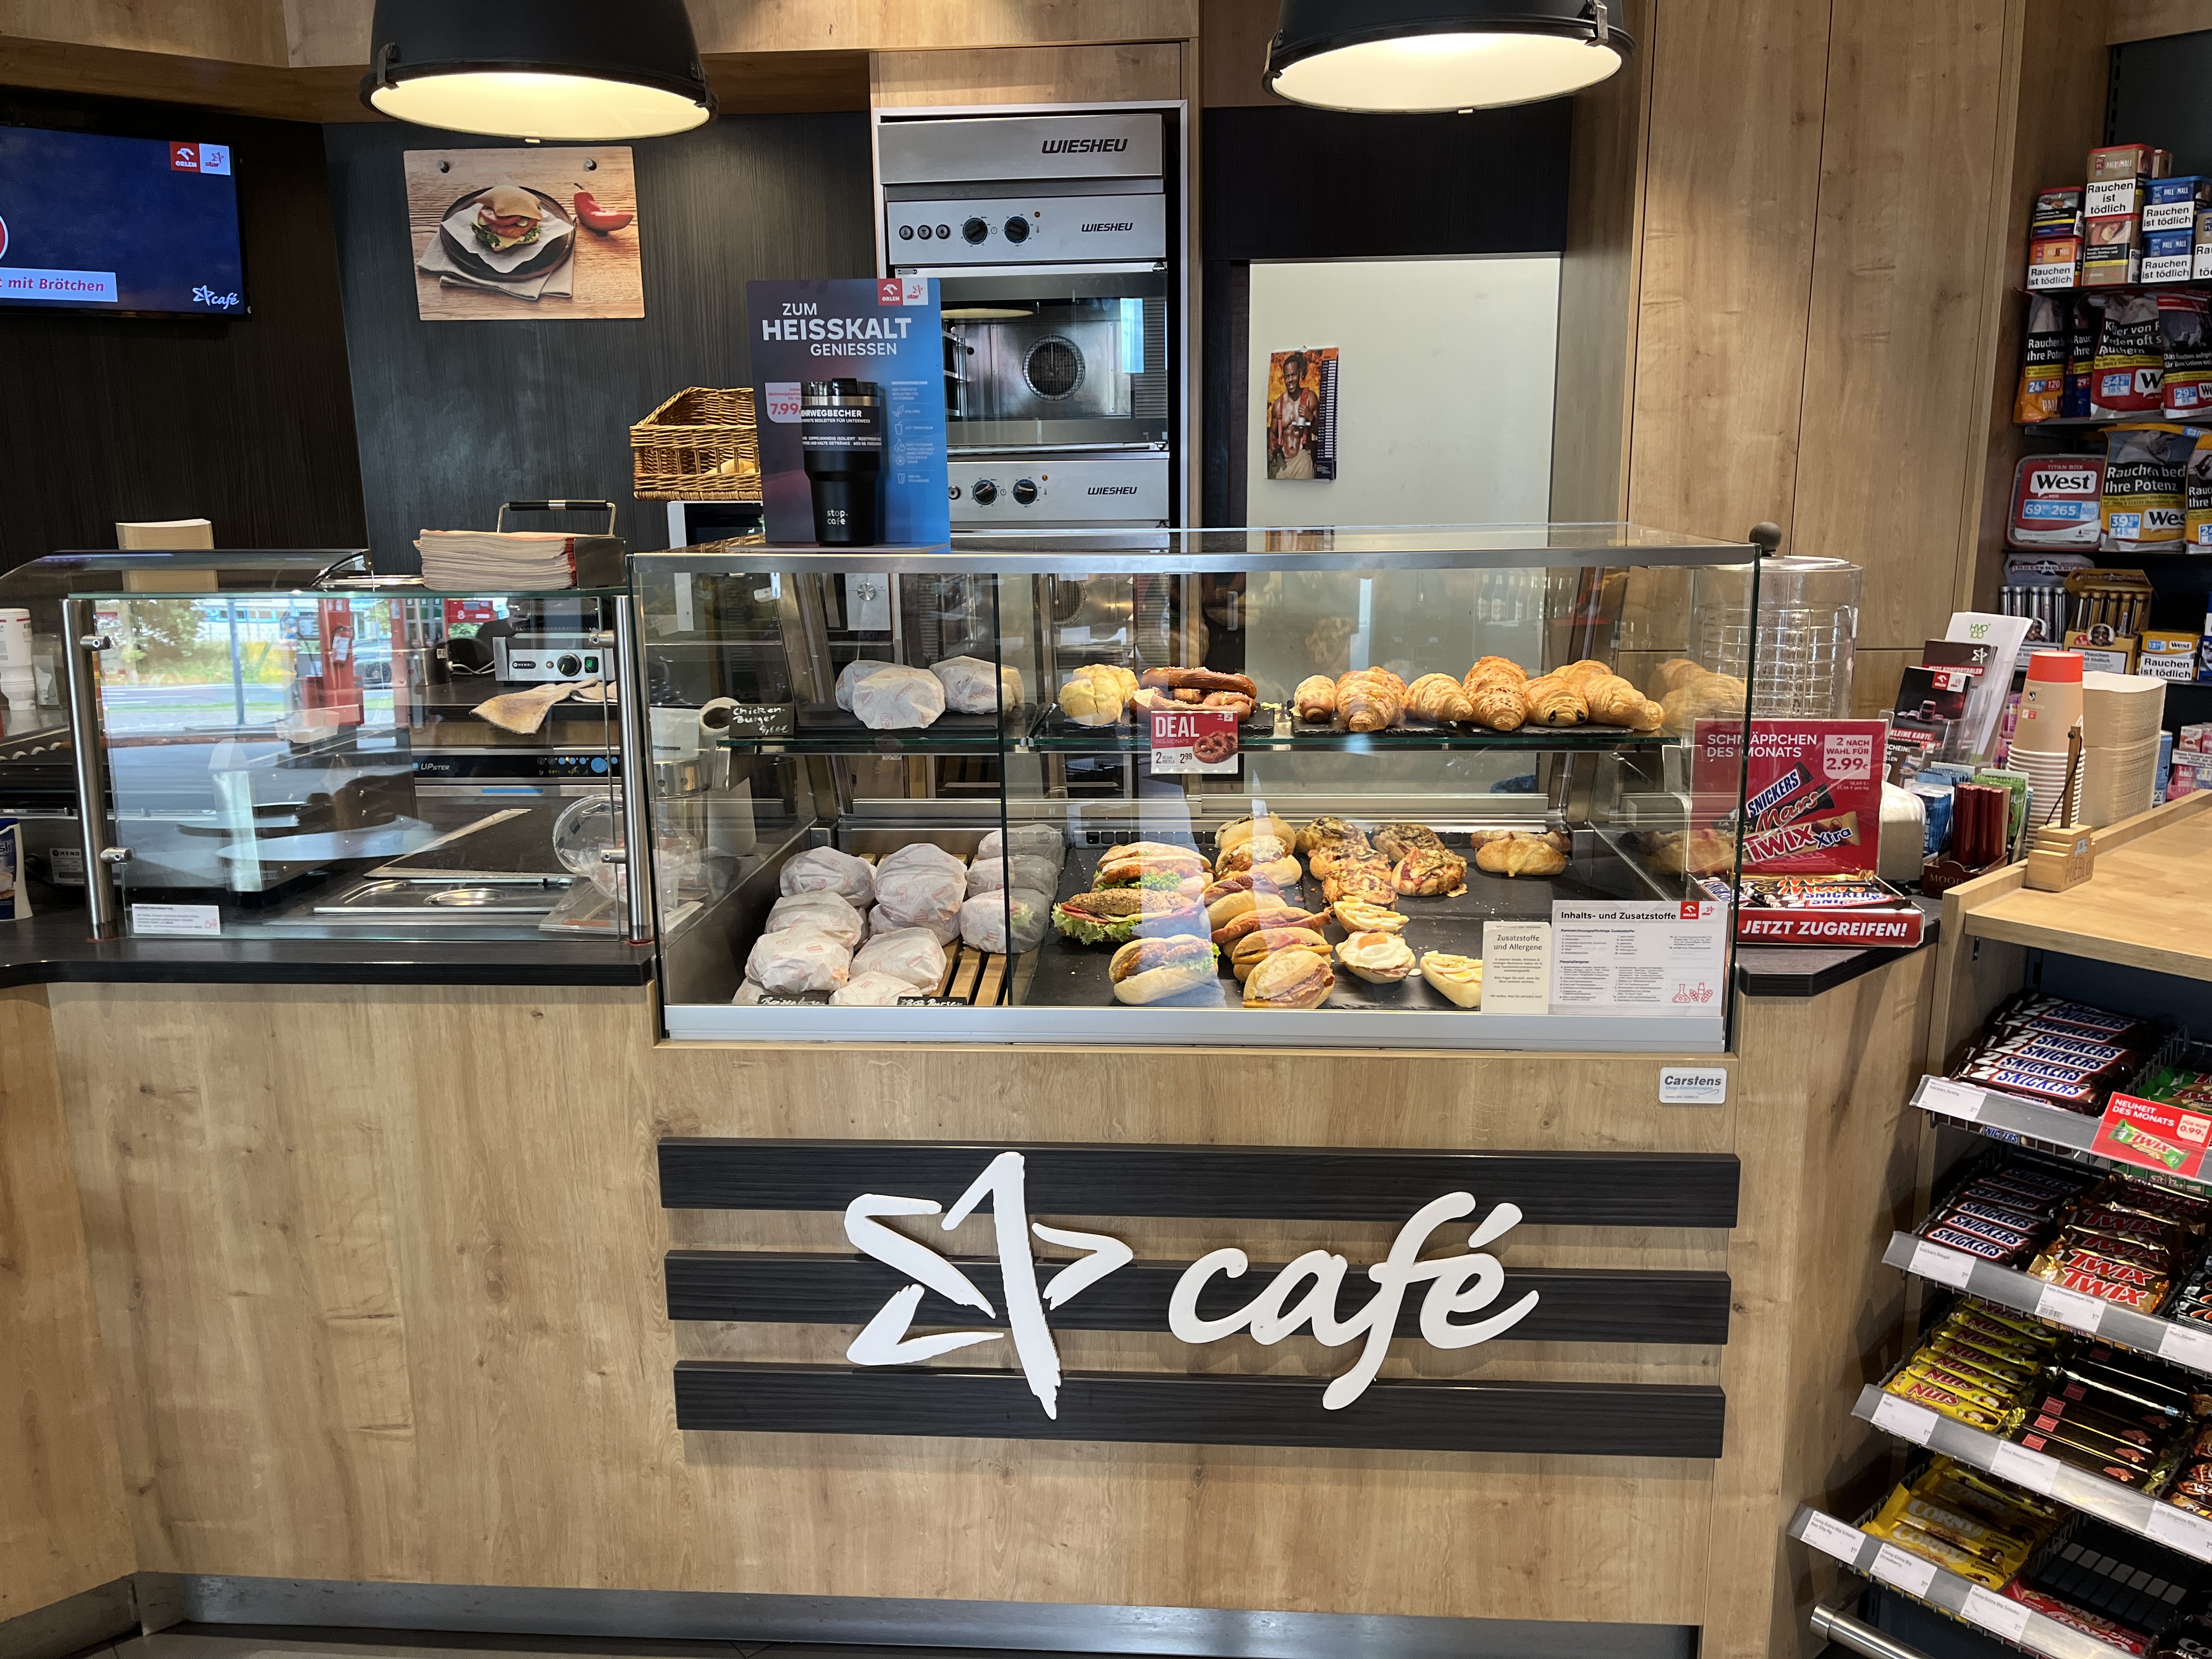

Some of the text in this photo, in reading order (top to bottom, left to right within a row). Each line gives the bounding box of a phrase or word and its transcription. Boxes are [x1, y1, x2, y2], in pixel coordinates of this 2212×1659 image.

[1042, 138, 1128, 154] WIESHEU
[2087, 182, 2134, 194] Rauchen
[2102, 194, 2116, 202] ist
[2090, 204, 2126, 214] tödlich
[2146, 207, 2189, 217] Rauchen
[1081, 222, 1133, 232] WIESHEU
[2143, 216, 2191, 227] ist tödlich
[2145, 259, 2188, 269] Rauchen
[2030, 267, 2071, 276] Rauchen
[2142, 269, 2190, 279] ist tödlich
[8, 276, 104, 291] mit Brötchen
[2028, 275, 2072, 286] ist tödlich
[210, 292, 240, 309] café
[782, 302, 818, 317] ZUM
[762, 317, 912, 341] HEISSKALT
[2131, 324, 2152, 334] von
[2136, 335, 2153, 345] oft
[810, 342, 897, 357] GENIESSEN
[2027, 350, 2045, 361] Ihre
[2107, 465, 2159, 479] Rauchen
[2036, 474, 2091, 490] West
[2105, 479, 2177, 493] Ihre Potenz
[1087, 486, 1137, 495] WIESHEU
[2051, 505, 2076, 516] 265
[2148, 511, 2185, 526] Wes
[2143, 658, 2190, 668] Rauchen
[2140, 667, 2191, 679] ist tödlich
[732, 714, 776, 726] Burger
[1155, 716, 1200, 737] DEAL
[1836, 737, 1844, 746] 2
[1156, 752, 1162, 764] 2
[1707, 747, 1734, 758] DES
[1739, 747, 1802, 758] MONATS
[1853, 747, 1869, 755] FÜR
[1826, 758, 1868, 771] 2.99€
[1747, 772, 1800, 817] SNICKERS
[1757, 791, 1819, 831] Mars
[1814, 827, 1853, 849] Xtra
[1561, 911, 1596, 919] Inhalts-
[1619, 912, 1677, 920] Zusatzstoffe
[1741, 921, 1908, 937] JETZT ZUGREIFEN!
[1509, 943, 1542, 952] Allergene
[2047, 1008, 2130, 1030] SNICKERS
[2030, 1019, 2111, 1042] SNICKERS
[2036, 1035, 2122, 1059] SNICKERS
[2022, 1046, 2108, 1070] SNICKERS
[2000, 1057, 2085, 1081] SNICKERS
[1664, 1075, 1722, 1085] Carstens
[1997, 1071, 2083, 1097] SNICKERS
[2115, 1098, 2157, 1114] NEUHEIT
[2112, 1106, 2175, 1127] DES MONATS
[1961, 1202, 2033, 1229] SNICKERS
[1950, 1216, 2023, 1245] SNICKERS
[1931, 1229, 2003, 1257] SNICKERS
[1168, 1190, 1539, 1410] café
[1921, 1367, 1975, 1391] Nuts
[1905, 1382, 1960, 1406] Nuts
[1909, 1500, 1984, 1538] CORNY
[1985, 1537, 2011, 1550] Banana
